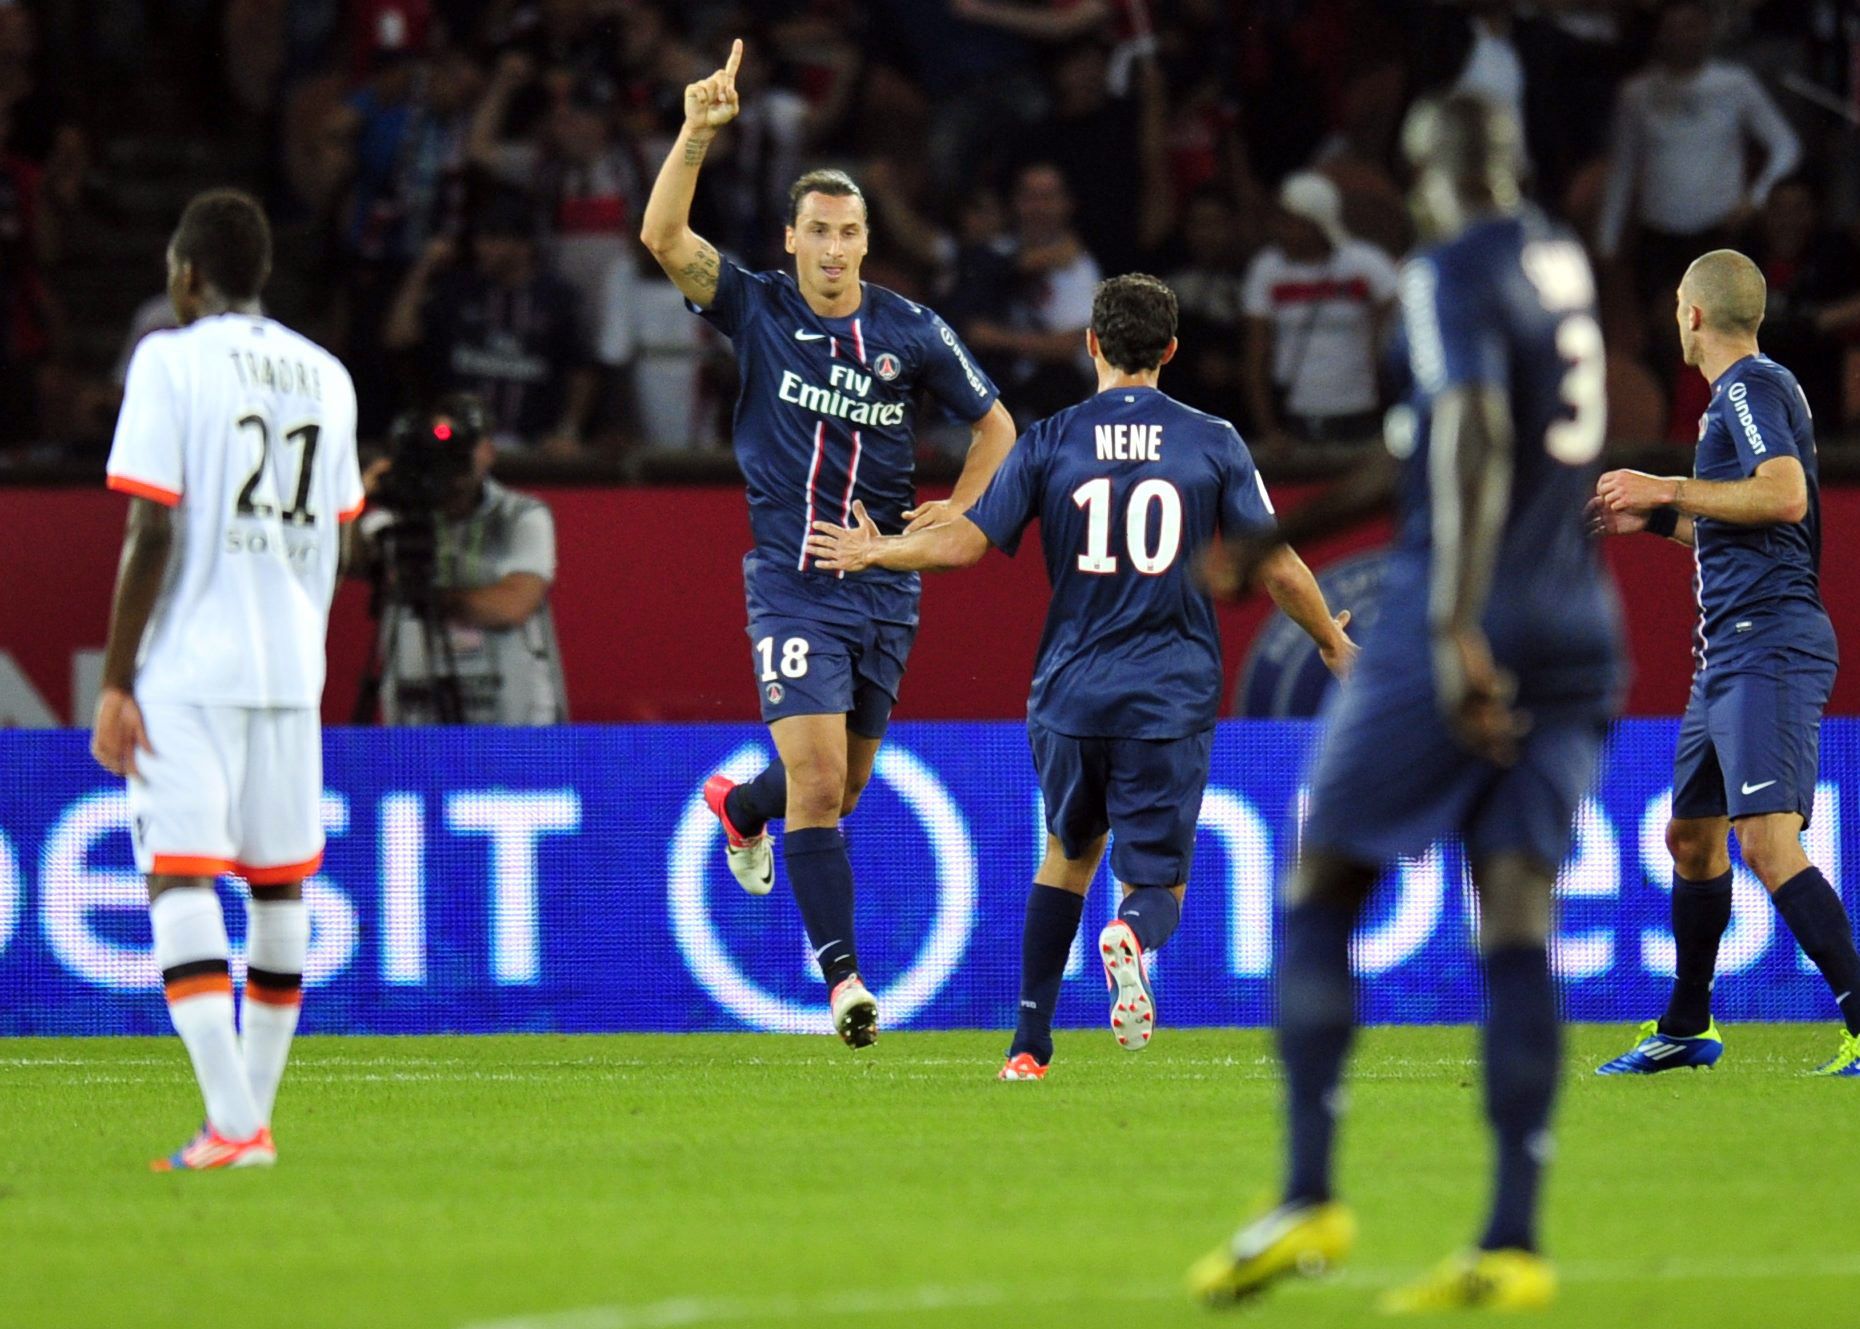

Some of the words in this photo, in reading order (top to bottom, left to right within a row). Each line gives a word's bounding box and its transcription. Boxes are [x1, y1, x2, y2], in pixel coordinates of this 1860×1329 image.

[778, 371, 904, 426] Emirates
[830, 365, 871, 397] Fly
[1545, 313, 1606, 465] 3
[236, 414, 320, 524] 21
[1094, 424, 1163, 460] NENE
[1072, 477, 1182, 574] 10
[756, 636, 809, 682] 18
